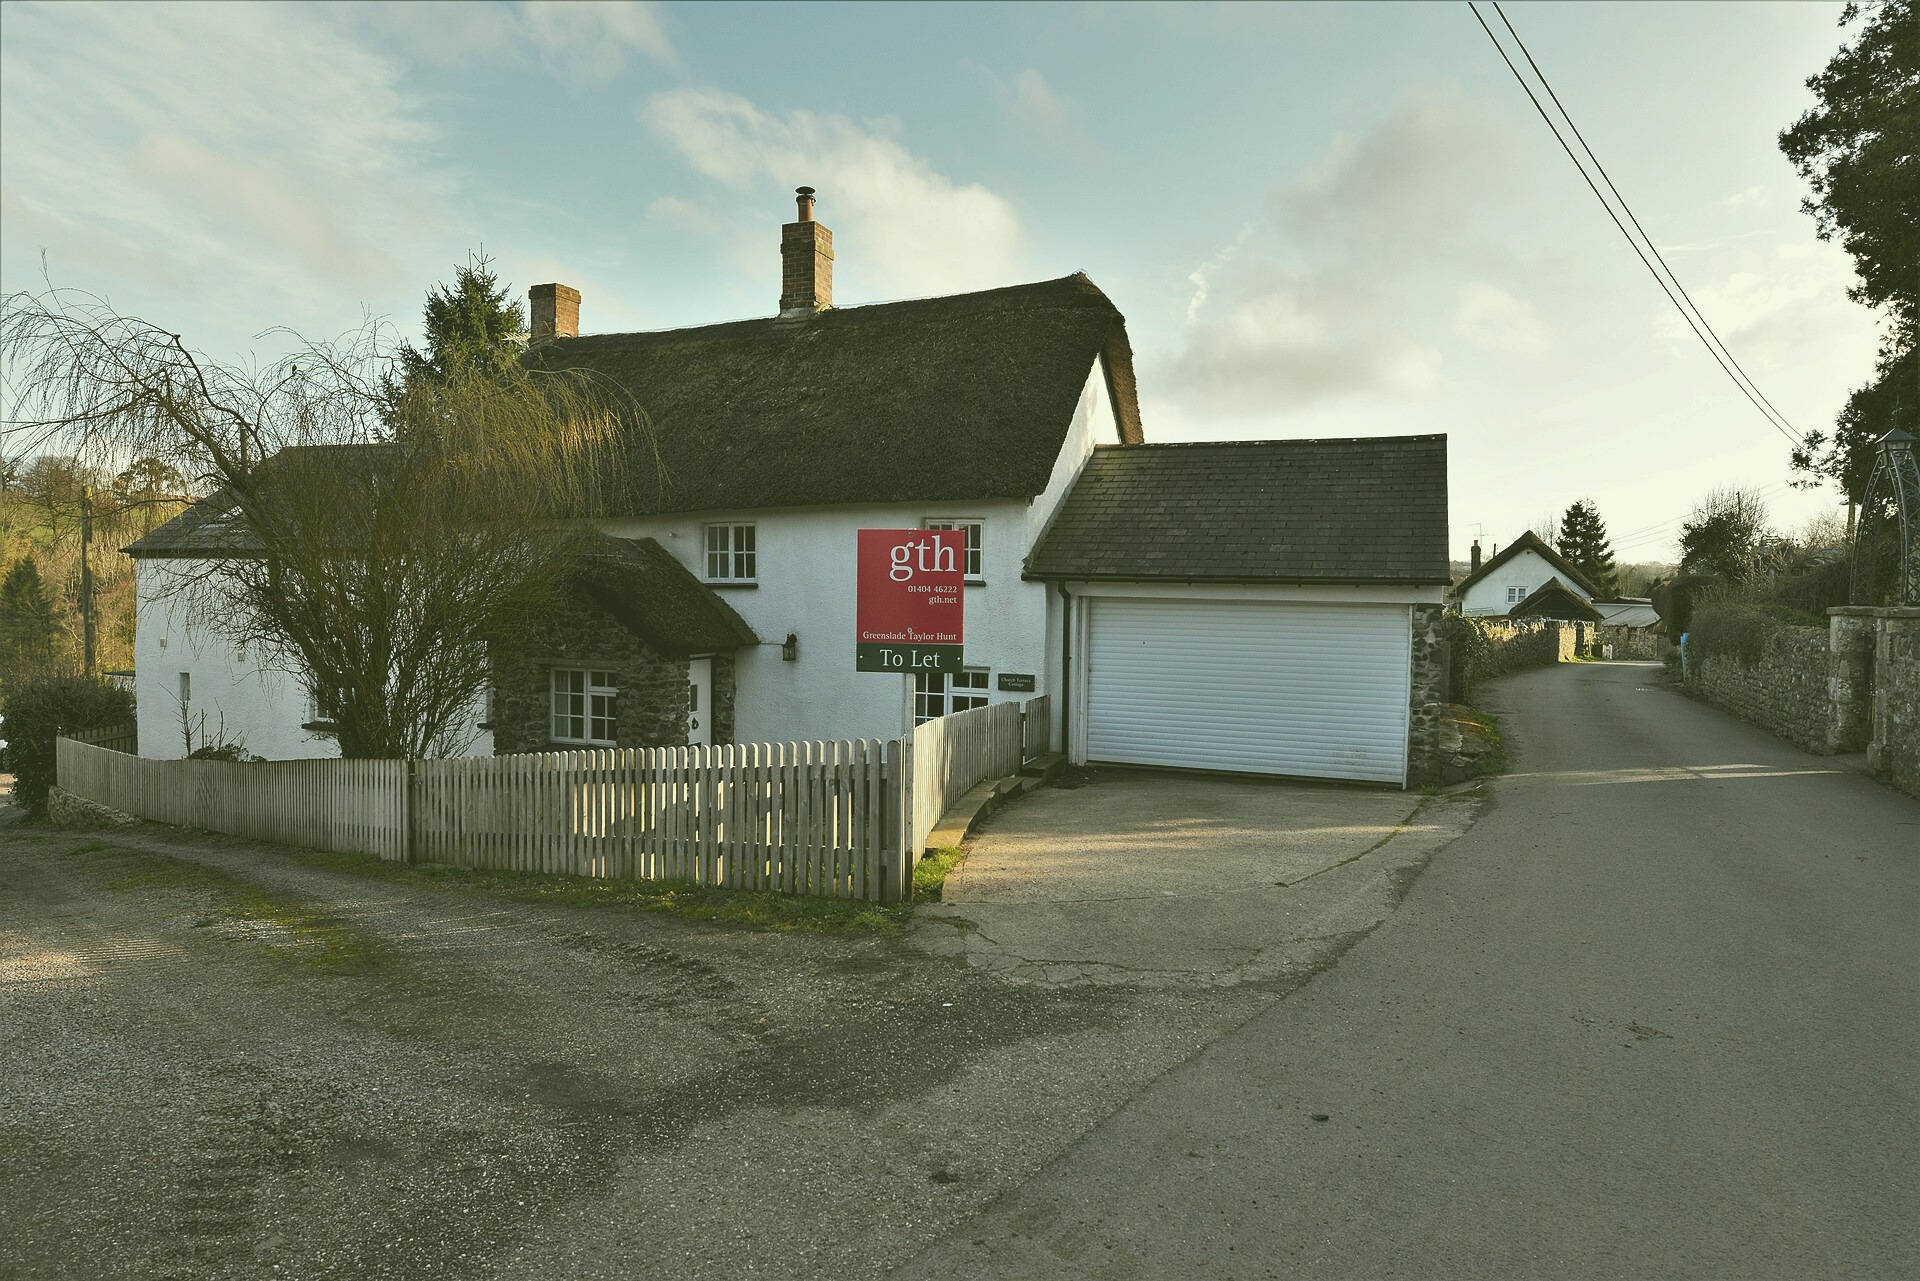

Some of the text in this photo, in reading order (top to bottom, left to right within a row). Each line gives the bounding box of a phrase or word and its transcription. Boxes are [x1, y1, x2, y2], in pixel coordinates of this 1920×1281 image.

[889, 534, 958, 582] gth
[907, 585, 958, 593] 01404 46222
[928, 595, 958, 605] gth.net
[862, 631, 957, 642] Greenslade Taylor Hunt
[879, 649, 941, 668] To Let
